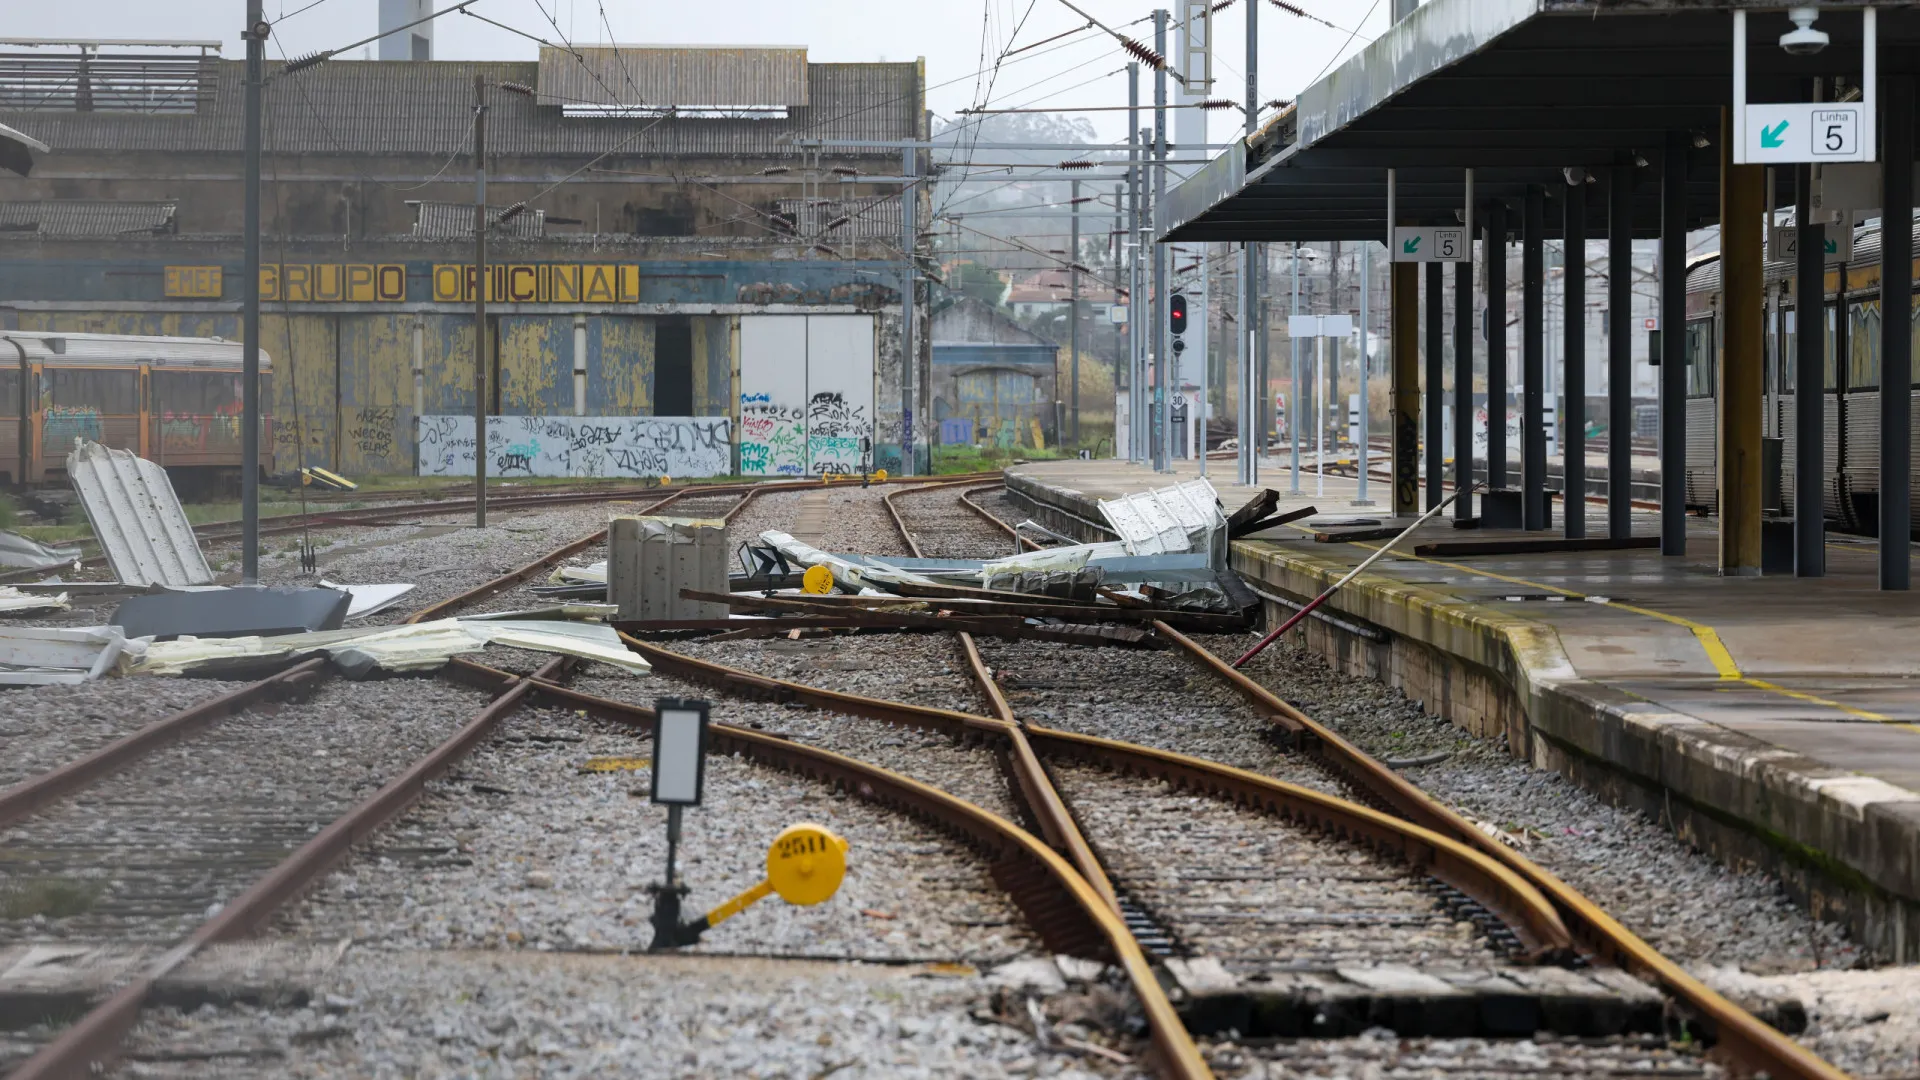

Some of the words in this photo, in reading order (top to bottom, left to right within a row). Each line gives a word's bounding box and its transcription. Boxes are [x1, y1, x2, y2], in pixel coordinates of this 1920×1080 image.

[1820, 112, 1849, 122] Linha
[1826, 125, 1843, 151] 5
[1443, 240, 1454, 256] 5
[1787, 240, 1796, 256] 4
[165, 269, 221, 293] EMEF
[260, 266, 403, 299] GRUPO
[1172, 396, 1183, 406] 30
[778, 833, 826, 859] 2511
